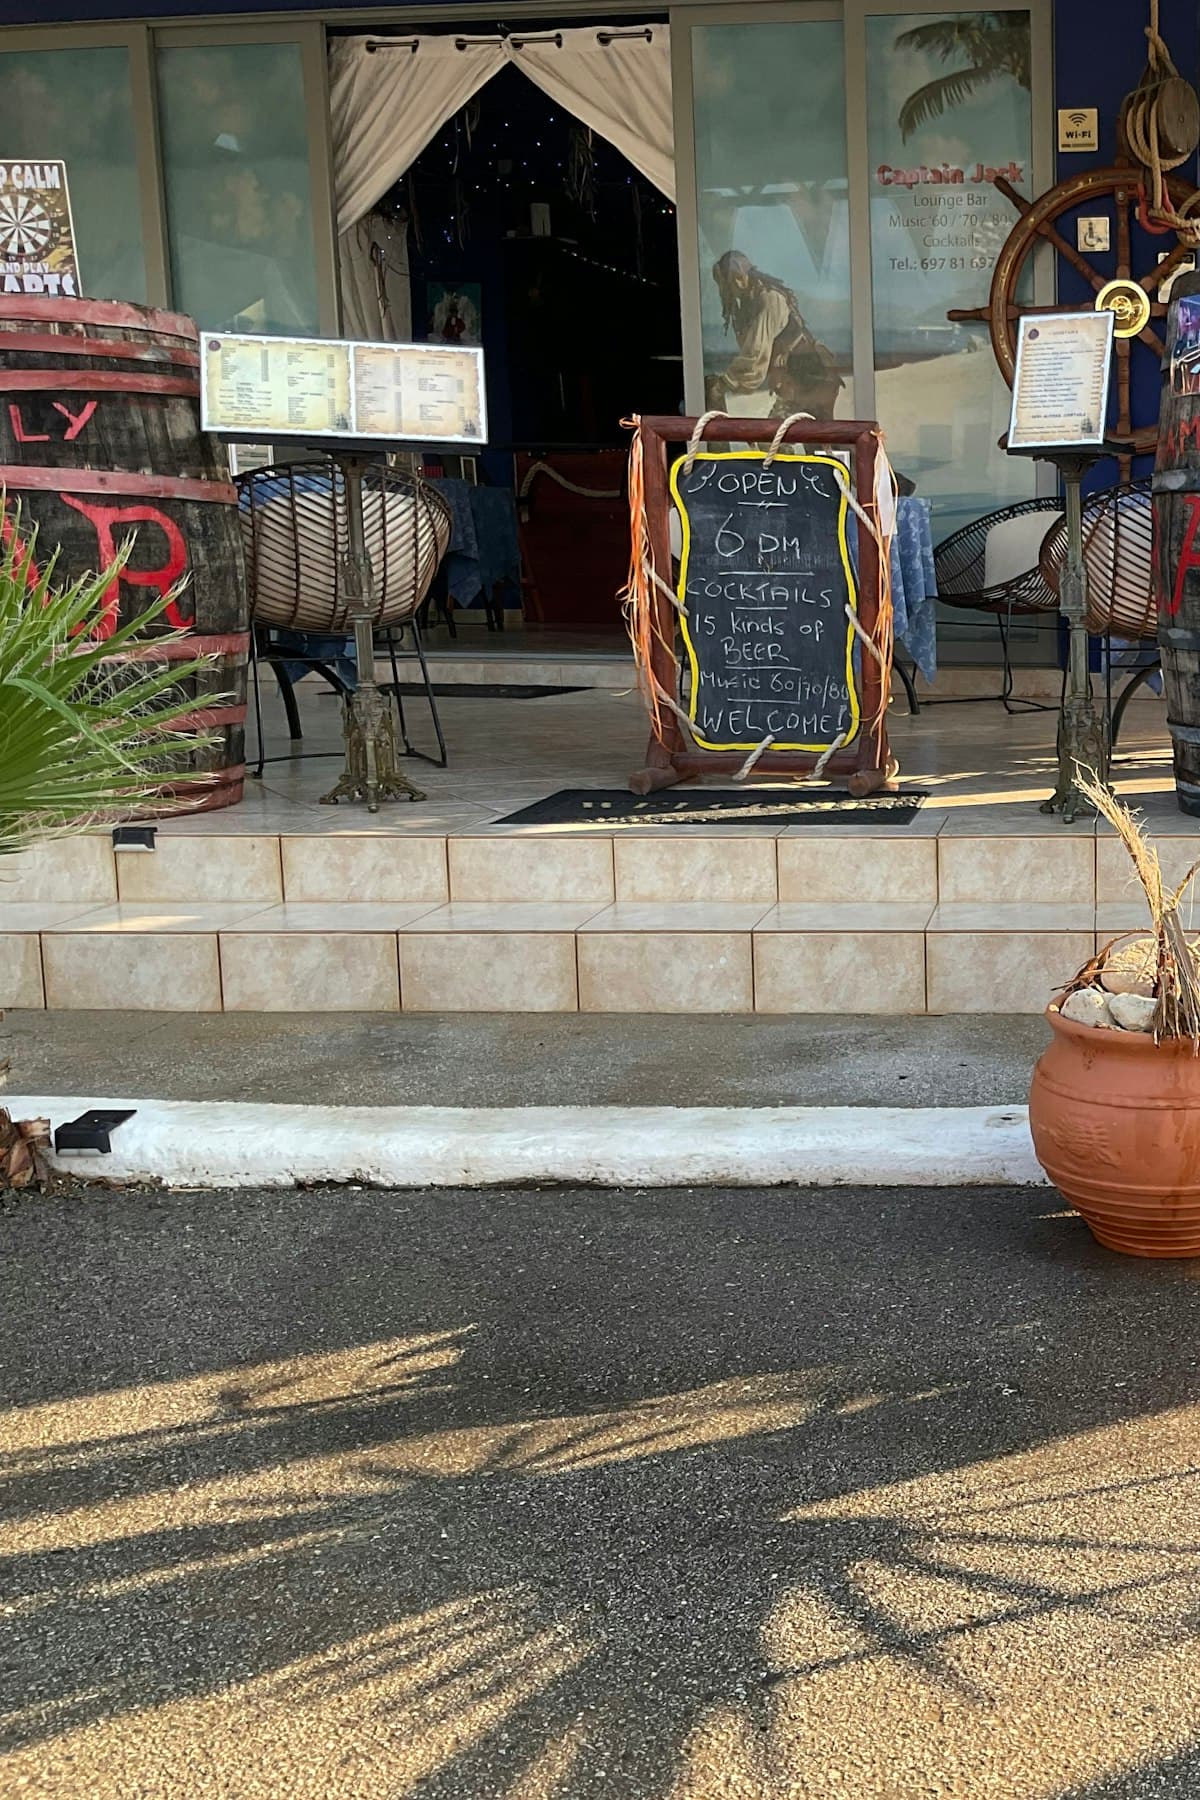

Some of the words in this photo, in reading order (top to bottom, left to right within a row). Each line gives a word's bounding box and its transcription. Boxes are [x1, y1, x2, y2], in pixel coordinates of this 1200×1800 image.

[1065, 129, 1092, 139] Wi-Fi
[11, 165, 61, 189] CALM
[876, 163, 965, 190] Captain
[970, 161, 1025, 184] Jack
[913, 194, 963, 210] Lounge
[966, 193, 989, 206] Bar
[889, 215, 929, 228] Music
[922, 234, 982, 248] Cocktails
[23, 262, 49, 273] PLAY
[920, 257, 946, 270] 697
[950, 257, 966, 270] 81
[718, 473, 797, 497] OPEN
[715, 512, 745, 558] 6
[686, 577, 833, 608] COCKTAILS
[695, 613, 716, 635] 15
[730, 611, 785, 635] kinds
[720, 636, 790, 665] BEER
